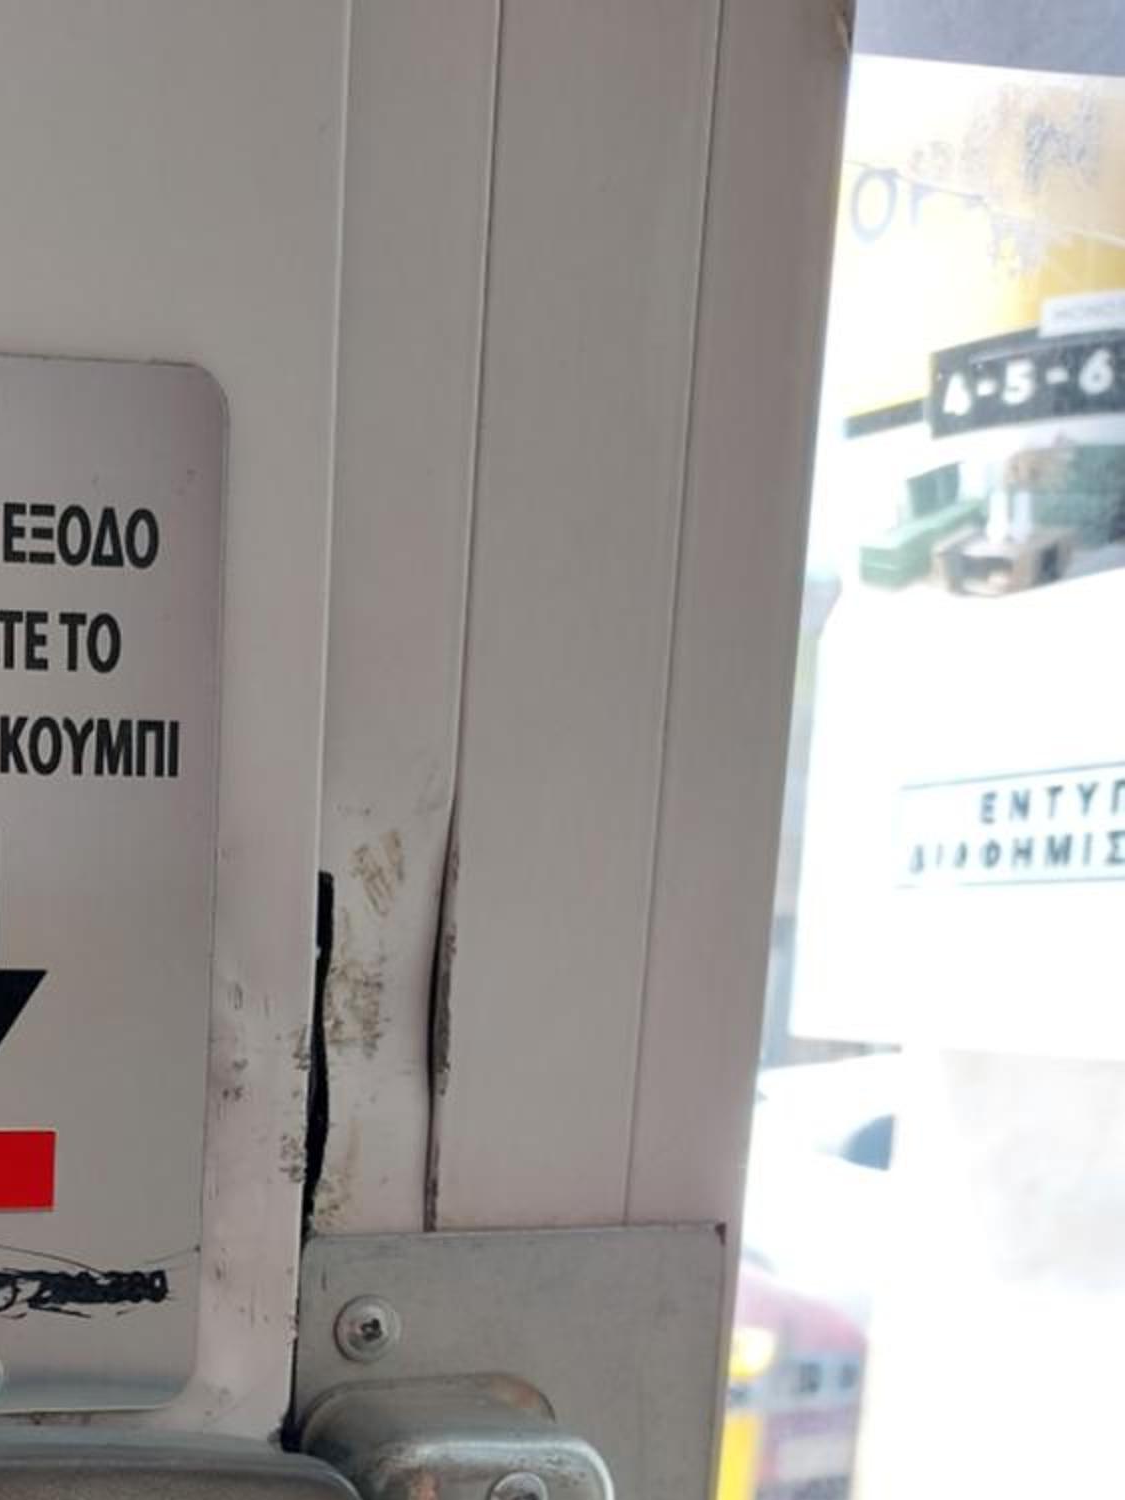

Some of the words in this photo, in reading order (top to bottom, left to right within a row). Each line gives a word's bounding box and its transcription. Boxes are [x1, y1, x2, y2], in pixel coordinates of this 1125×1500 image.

[2, 502, 160, 569] ΕΞΟΔΟ
[59, 612, 122, 674] ΤΟ
[0, 715, 179, 778] ΚΟΥΜΠΙ
